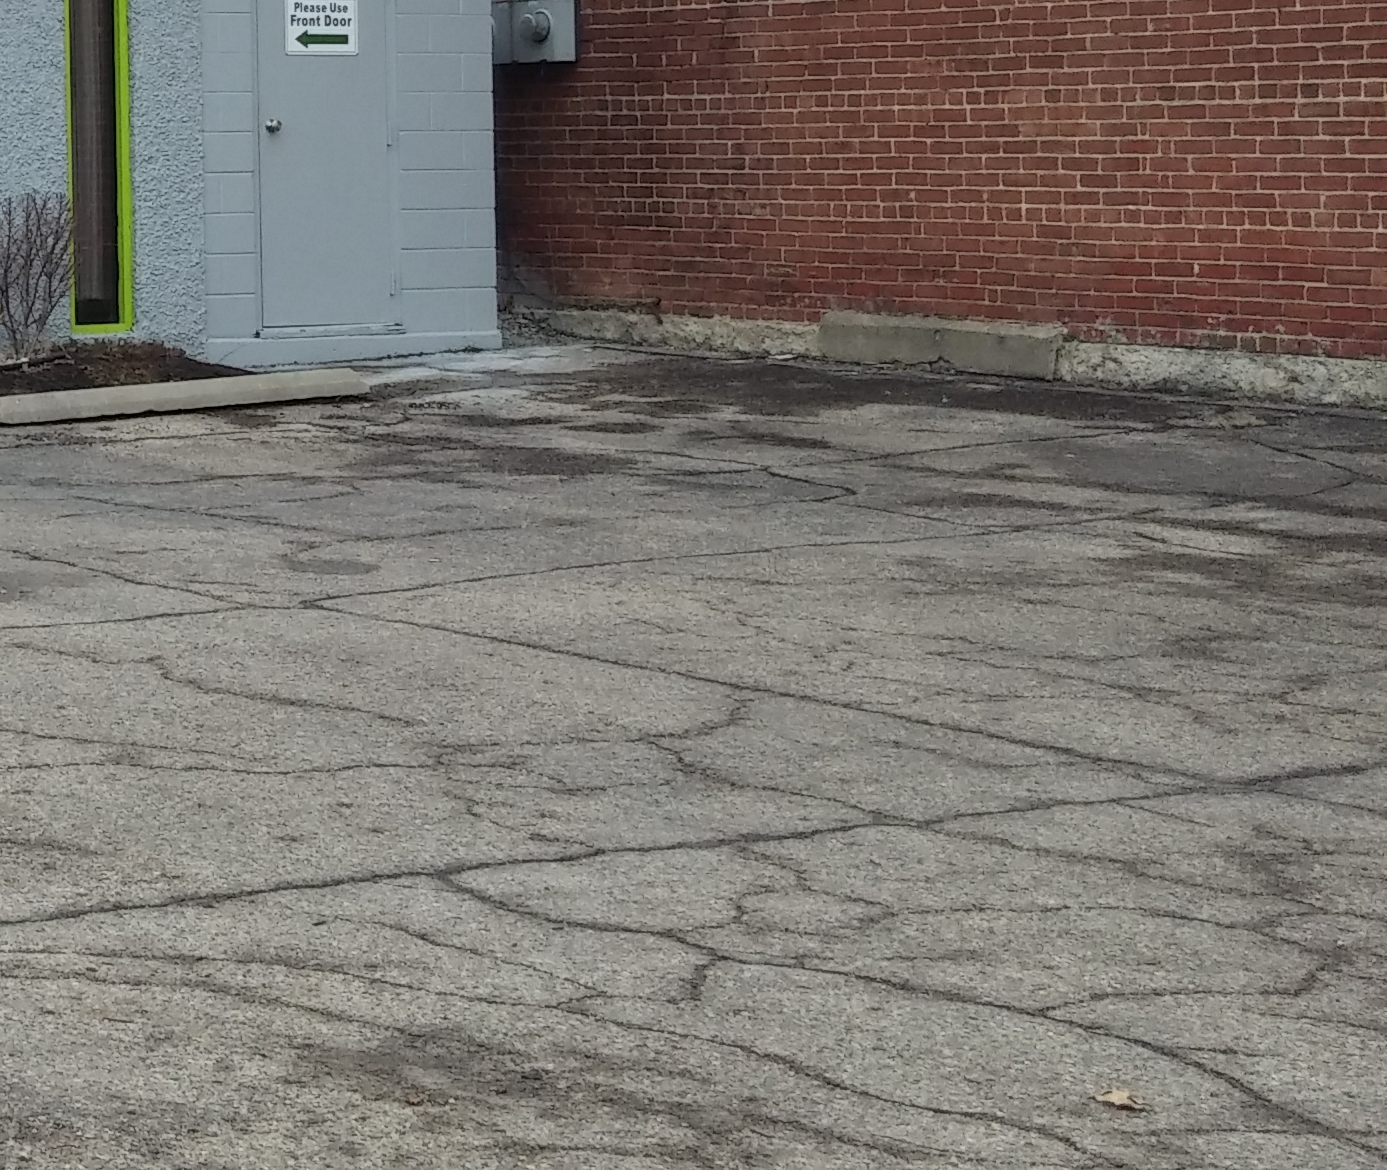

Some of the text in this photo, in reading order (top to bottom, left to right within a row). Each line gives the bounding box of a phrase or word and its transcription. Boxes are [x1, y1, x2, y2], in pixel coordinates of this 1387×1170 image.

[293, 2, 349, 14] Please Use
[290, 15, 353, 27] Front Door
